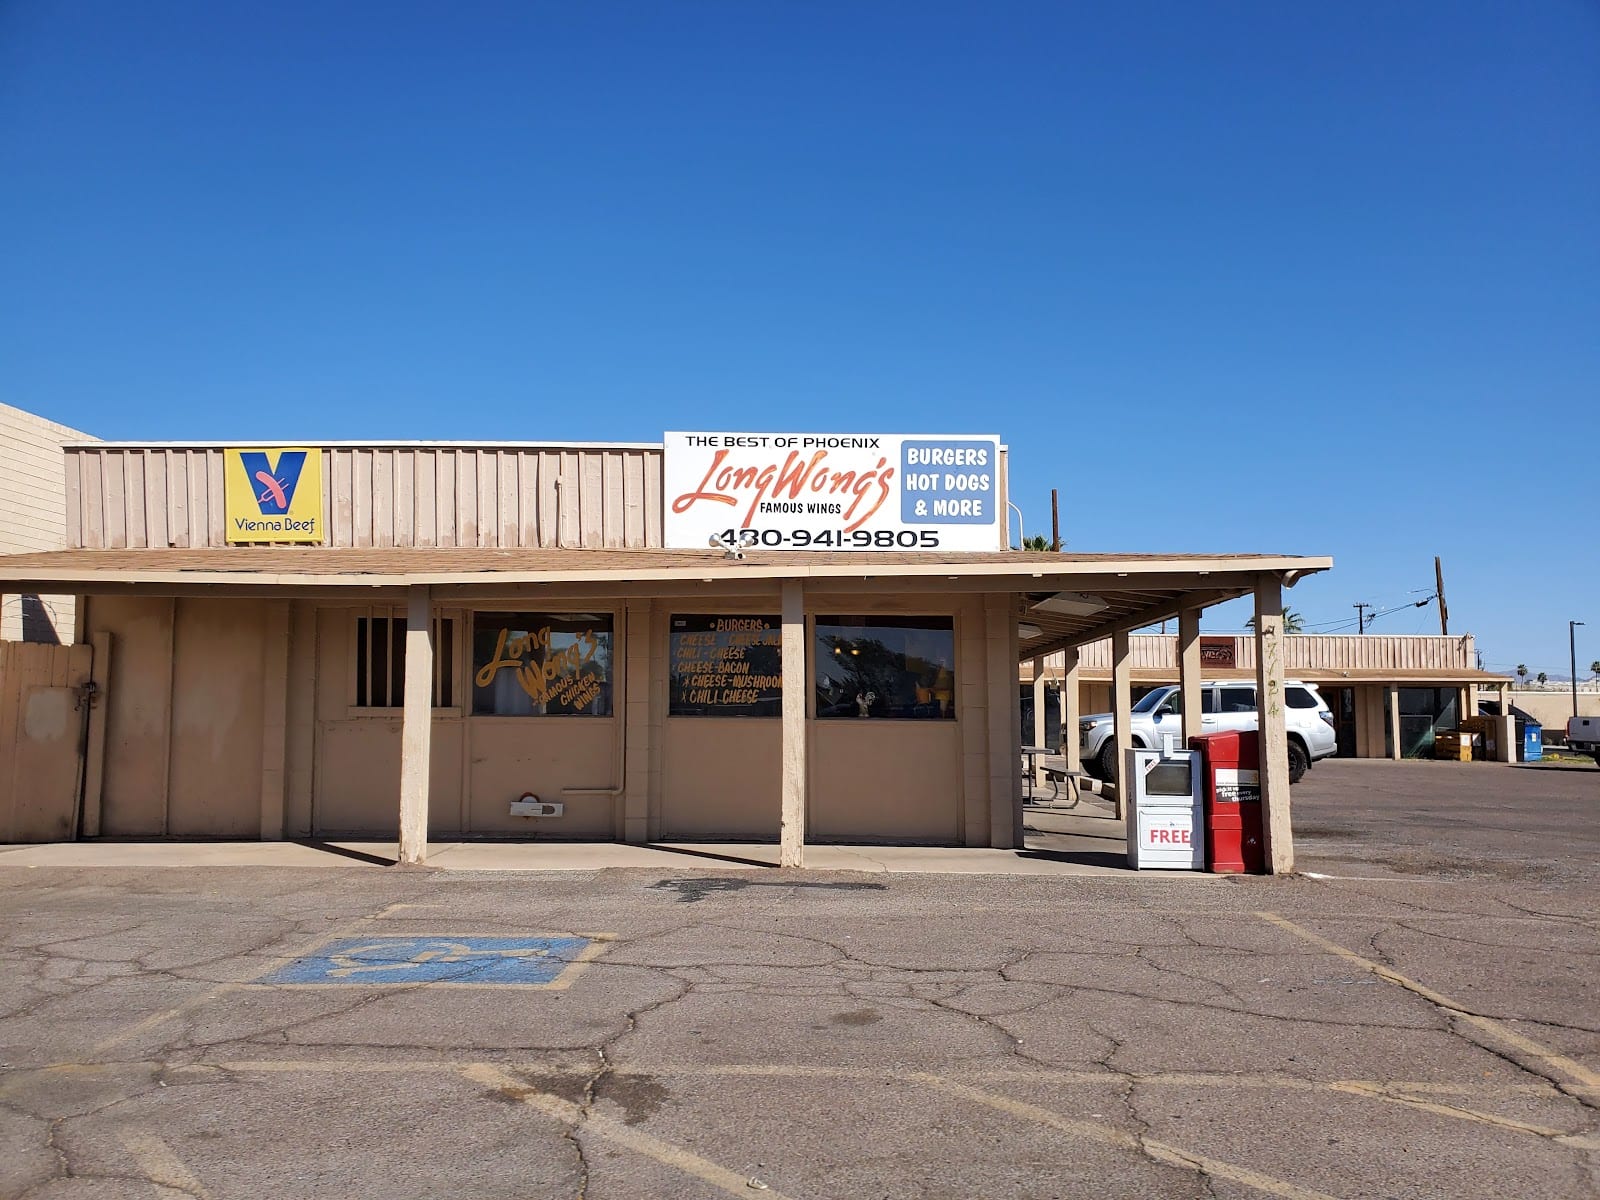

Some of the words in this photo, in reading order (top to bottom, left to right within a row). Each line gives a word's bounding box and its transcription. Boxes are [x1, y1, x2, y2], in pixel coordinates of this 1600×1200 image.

[685, 436, 718, 447] THE
[724, 436, 769, 448] BEST
[774, 437, 798, 448] OF
[803, 437, 880, 449] PHOENIX
[907, 448, 987, 466] BURGERS
[906, 473, 939, 491] HOT
[944, 474, 990, 492] DOGS
[672, 449, 777, 528] Long
[771, 450, 895, 534] Wong's
[760, 502, 803, 514] FAMOUS
[807, 503, 841, 514] WINGS
[914, 499, 928, 516] &
[933, 499, 982, 516] MORE
[235, 517, 282, 531] Vienna
[284, 517, 315, 534] Beef
[717, 618, 763, 632] BURGERS
[475, 627, 551, 687] Long
[689, 690, 718, 705] CHILI
[722, 689, 760, 705] CHEESE
[1150, 829, 1192, 844] FREE
